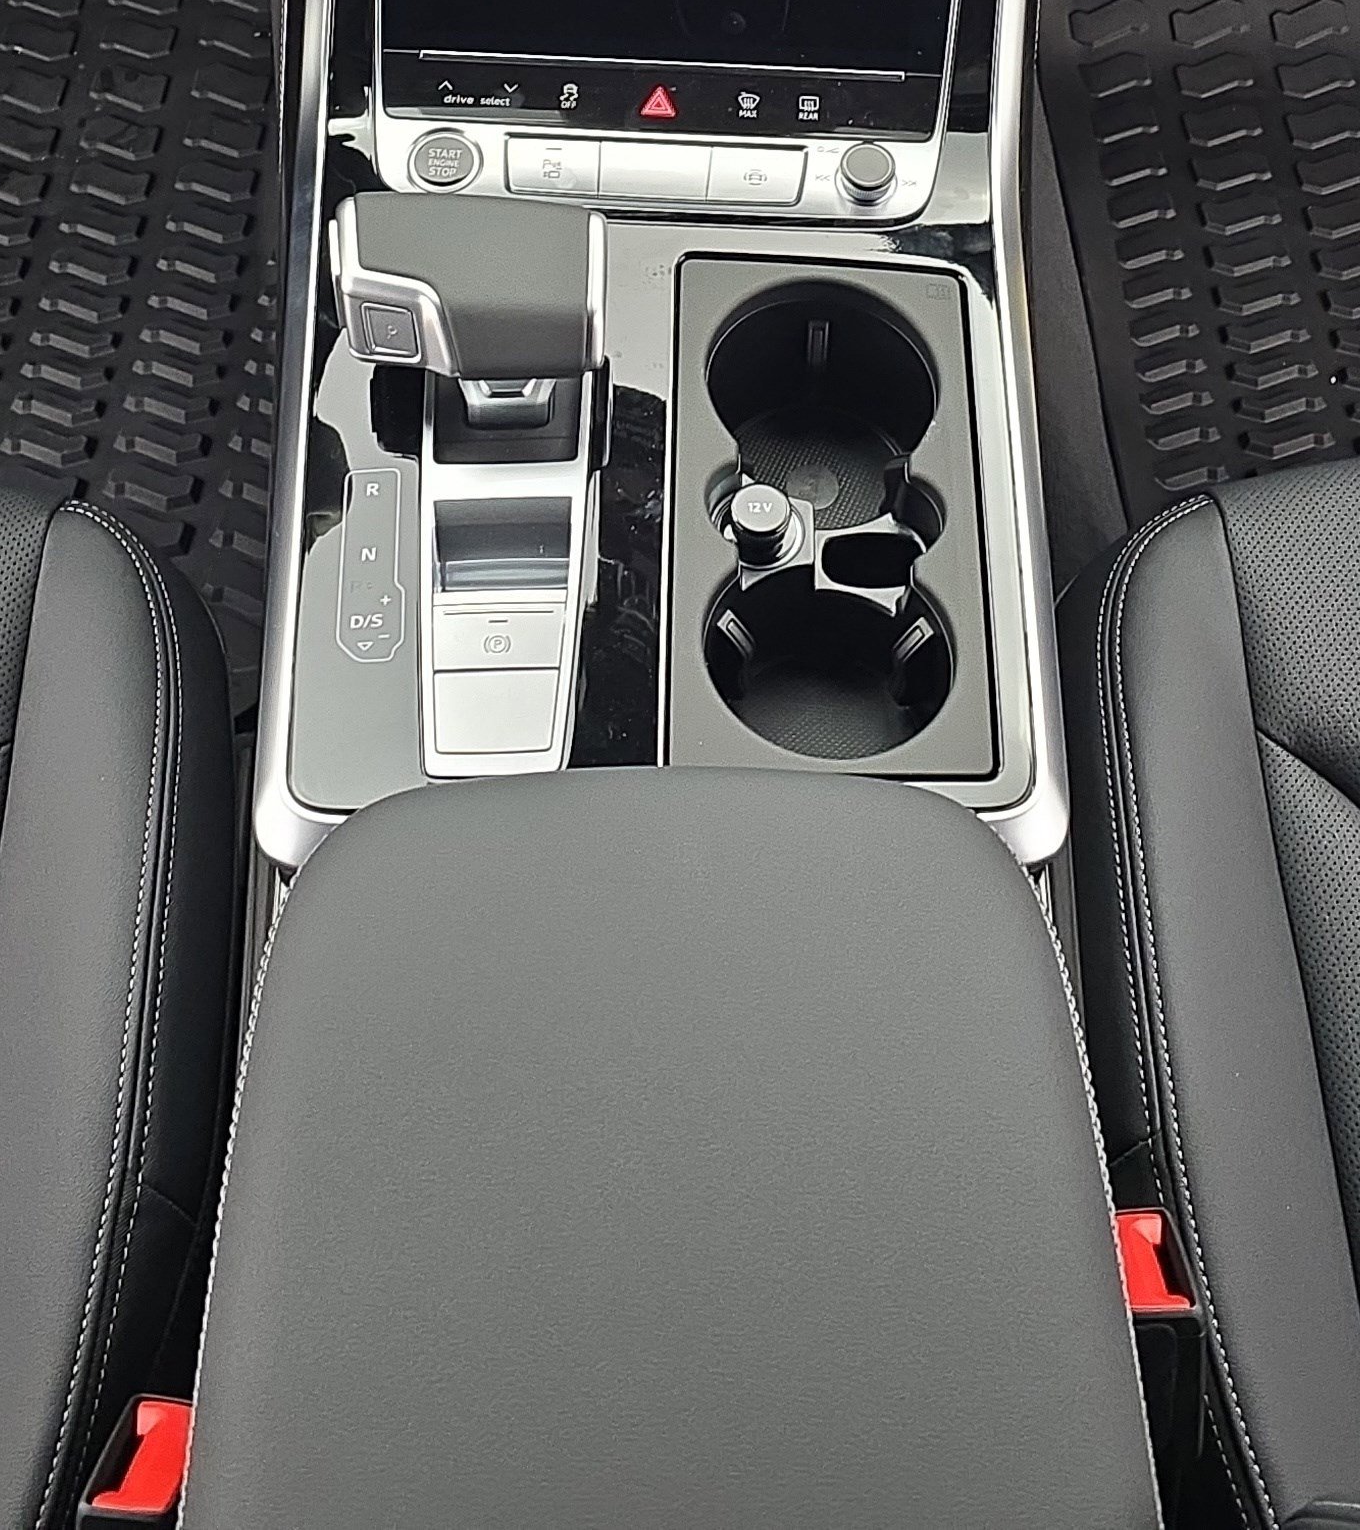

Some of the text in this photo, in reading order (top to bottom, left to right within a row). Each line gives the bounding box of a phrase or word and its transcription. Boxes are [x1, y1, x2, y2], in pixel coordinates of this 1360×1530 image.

[443, 94, 511, 107] drive select
[738, 110, 758, 118] MAX
[798, 112, 819, 121] REAR
[428, 148, 463, 159] START
[428, 159, 460, 168] ENGINE
[428, 167, 457, 178] STOP
[366, 483, 380, 497] R
[361, 547, 377, 562] N
[349, 613, 384, 629] D/S
